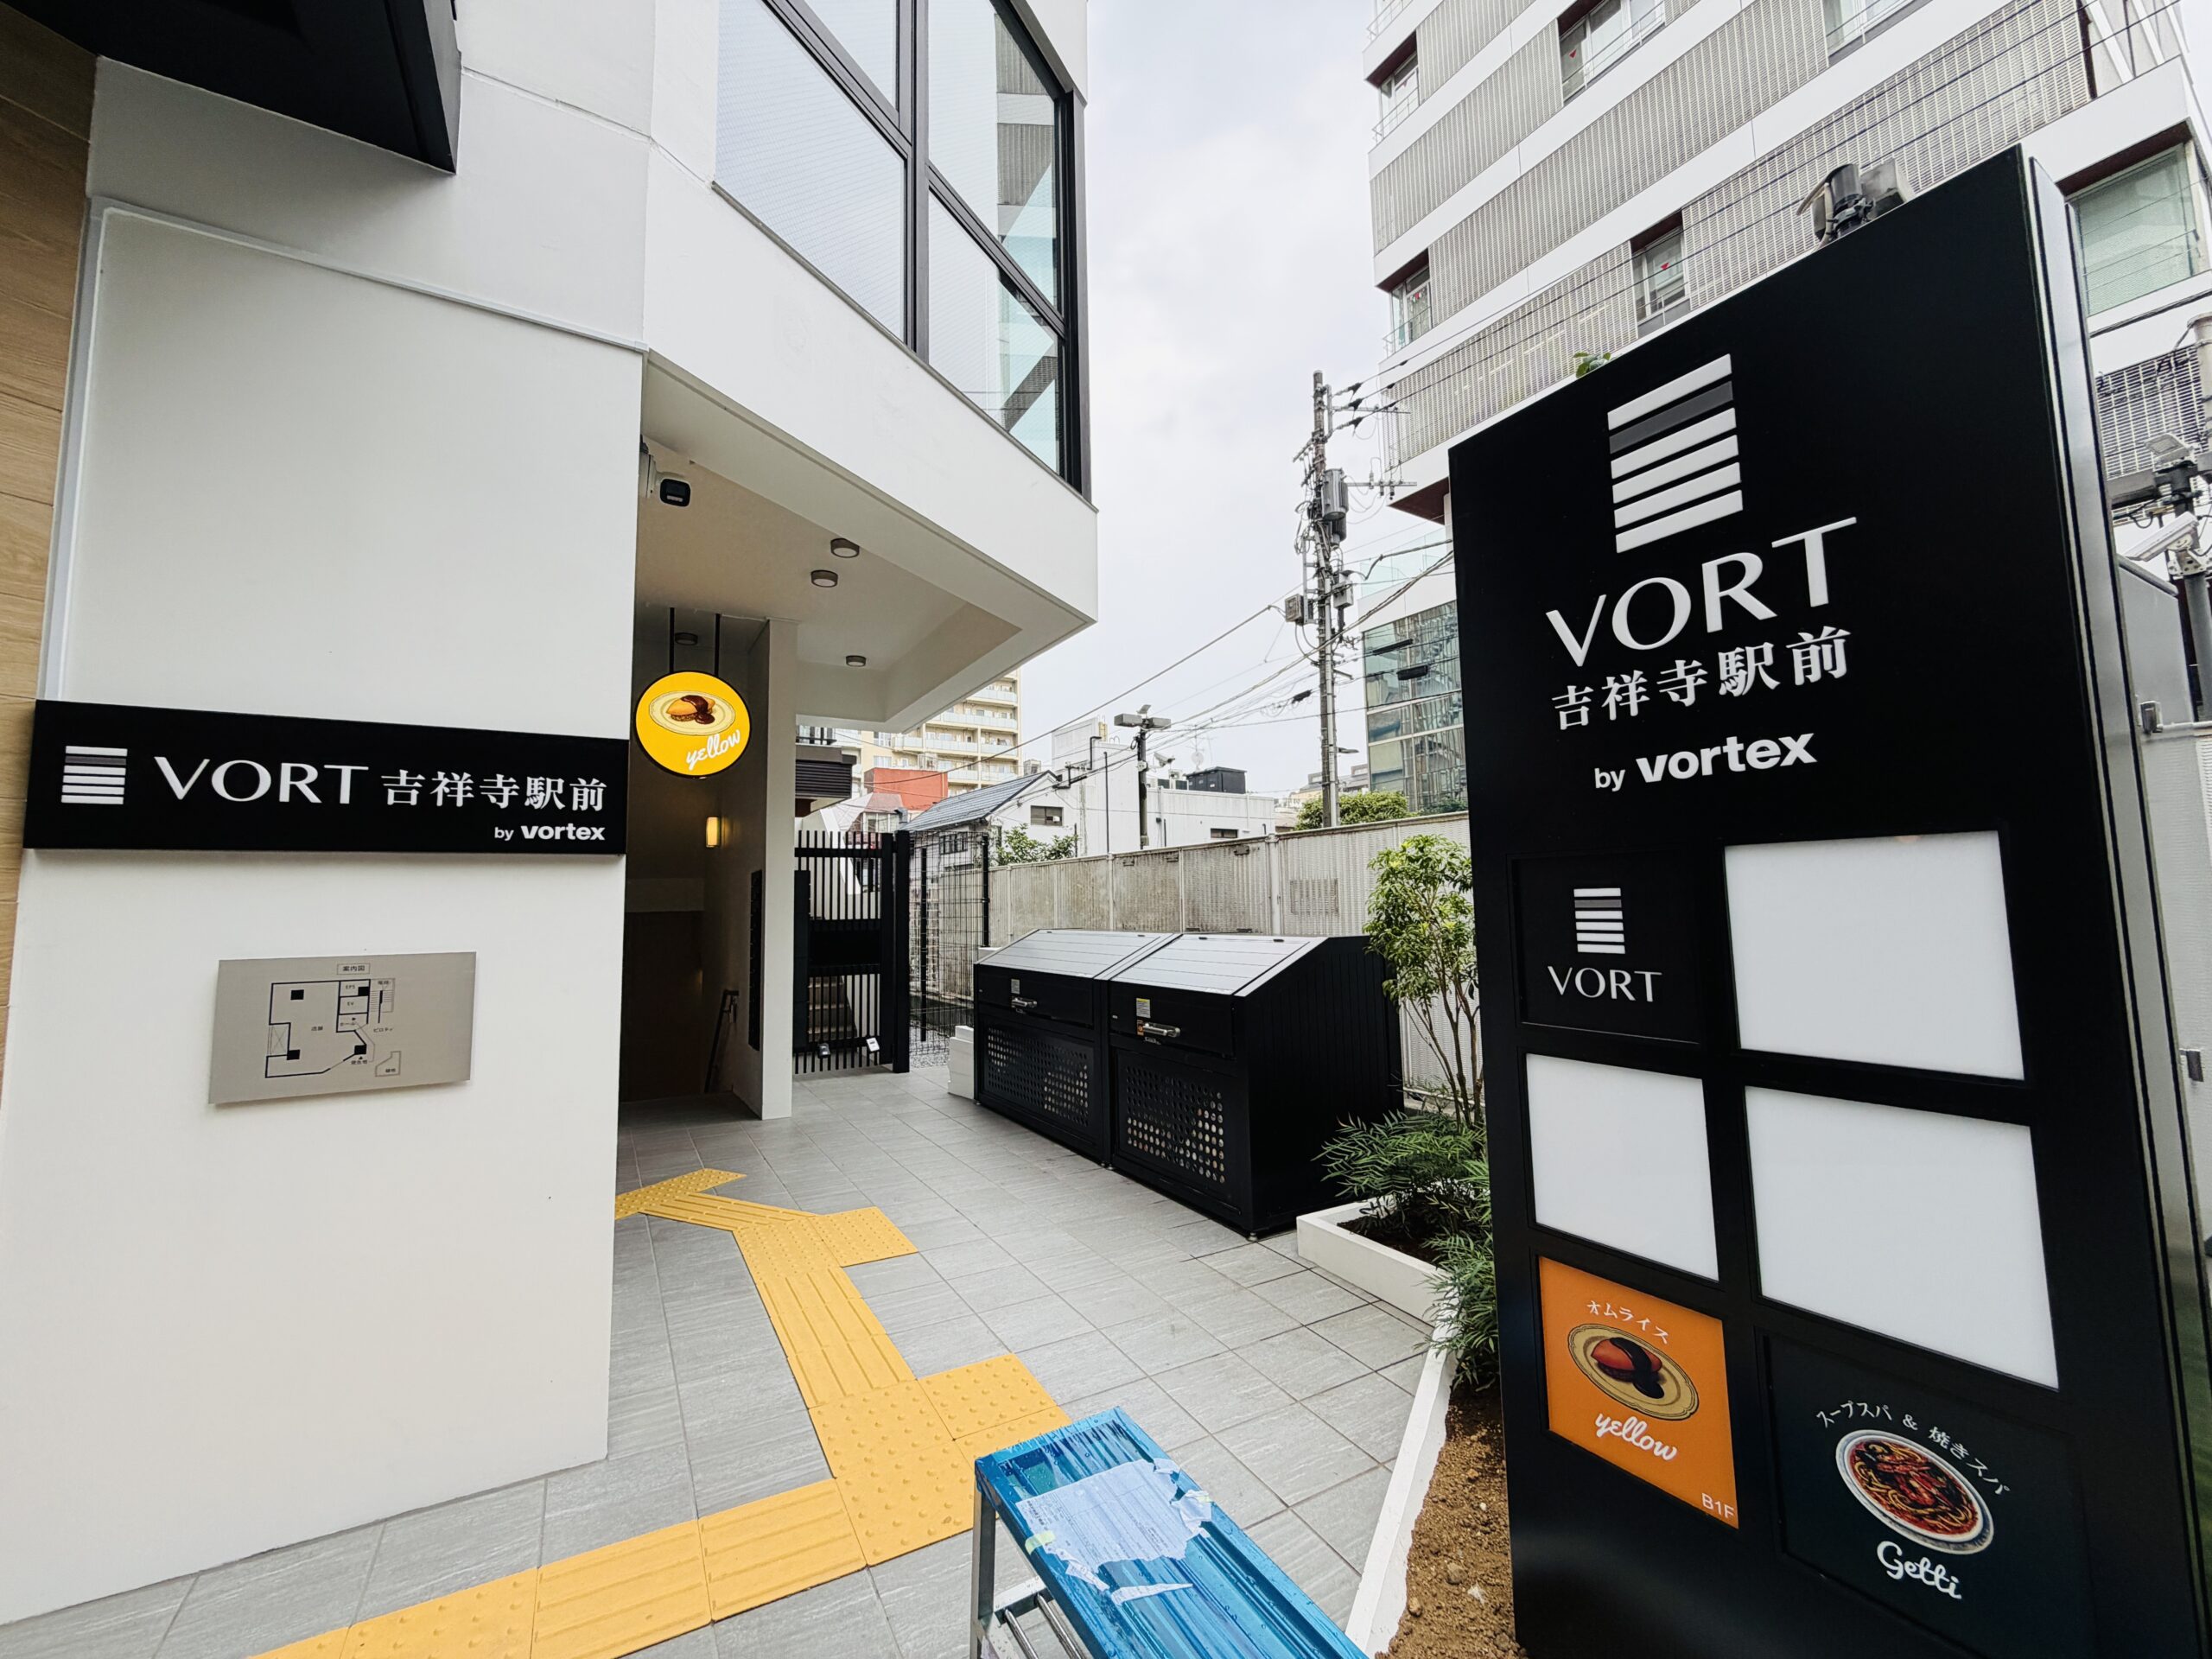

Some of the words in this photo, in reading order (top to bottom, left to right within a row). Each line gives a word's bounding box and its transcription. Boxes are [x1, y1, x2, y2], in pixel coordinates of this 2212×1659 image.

[1546, 517, 1857, 667] VORT
[1551, 626, 1851, 730] 吉祥寺駅前
[685, 729, 741, 771] yellow
[1594, 767, 1625, 792] by
[1636, 733, 1817, 784] vortex
[154, 756, 369, 804] VORT
[381, 769, 607, 811] 吉祥寺駅前
[494, 827, 514, 842] by
[520, 823, 606, 841] vortex
[1547, 966, 1662, 1002] VORT
[1586, 1300, 1669, 1344] オムライス
[1594, 1413, 1678, 1461] yellow
[1815, 1400, 1893, 1428] スープスパ
[1902, 1414, 1917, 1430] &
[1928, 1426, 2010, 1495] 焼きスパ
[1701, 1492, 1734, 1518] B1F
